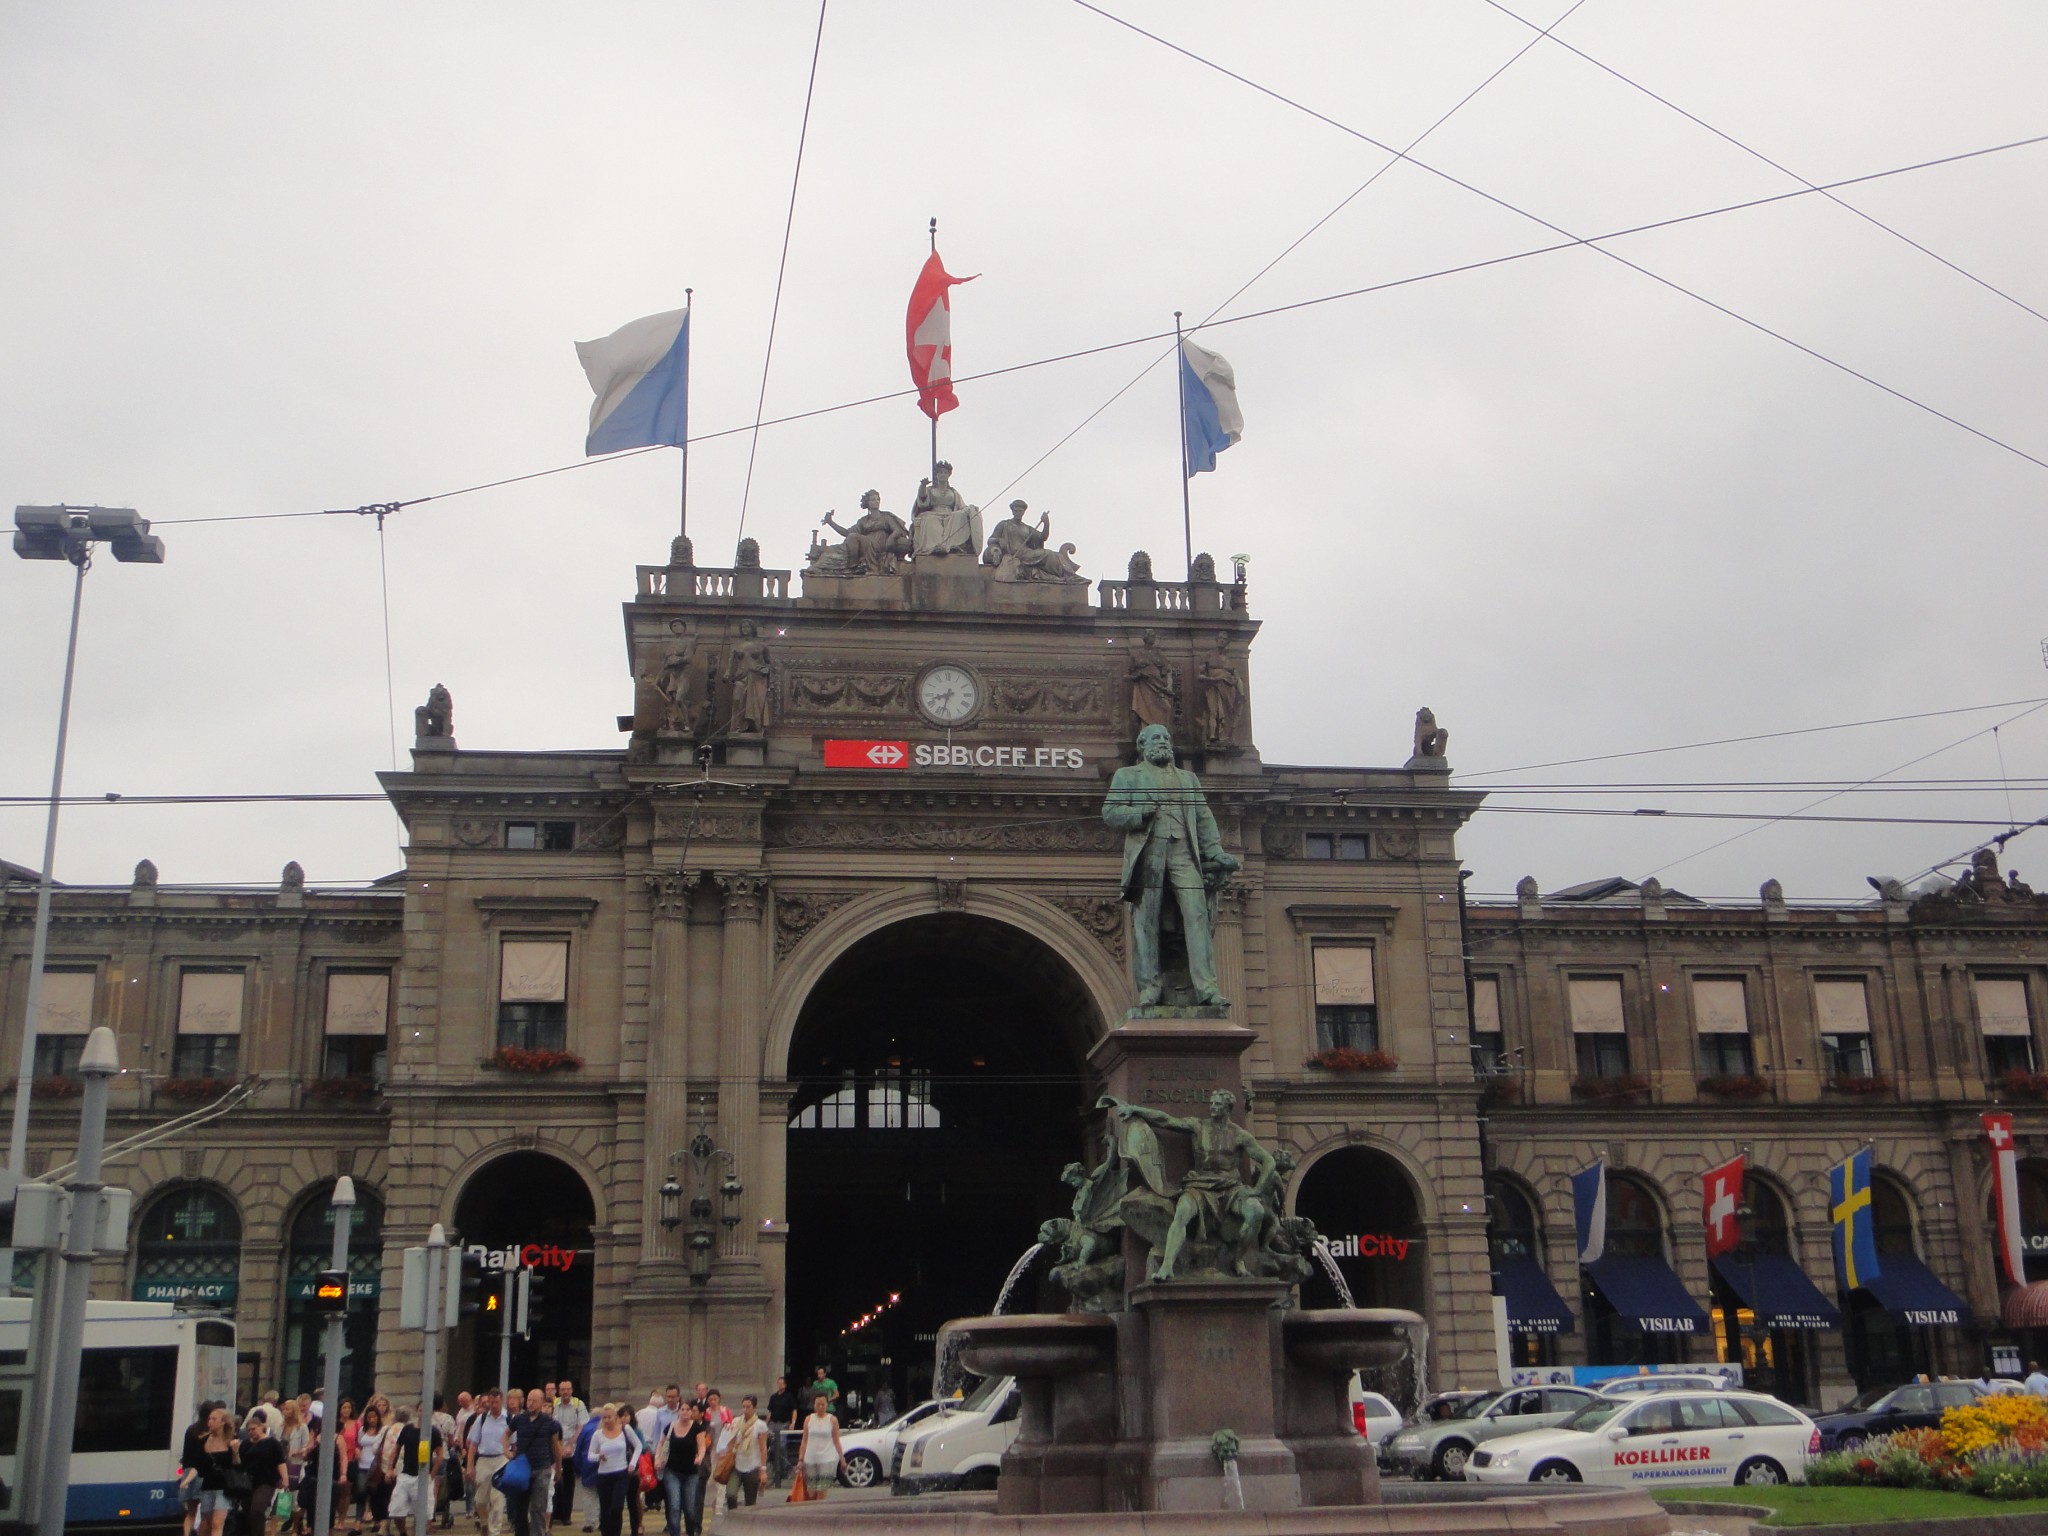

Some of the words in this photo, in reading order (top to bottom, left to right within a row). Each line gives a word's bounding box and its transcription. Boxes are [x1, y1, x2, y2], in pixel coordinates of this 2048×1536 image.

[915, 745, 968, 766] SBB
[975, 746, 1027, 767] CFF
[1034, 748, 1084, 769] FFS
[1142, 1087, 1212, 1103] ESCHE
[1311, 1233, 1409, 1260] RailCity
[467, 1243, 577, 1272] RalCity
[147, 1285, 224, 1298] PHAACY
[301, 1284, 373, 1295] AEKE
[1639, 1317, 1694, 1332] VISILAB
[1904, 1310, 1958, 1325] VISILAB
[1614, 1446, 1710, 1466] KOELLIKER
[1632, 1467, 1728, 1479] PAPERMANAGEMENT
[150, 1489, 164, 1499] 70
